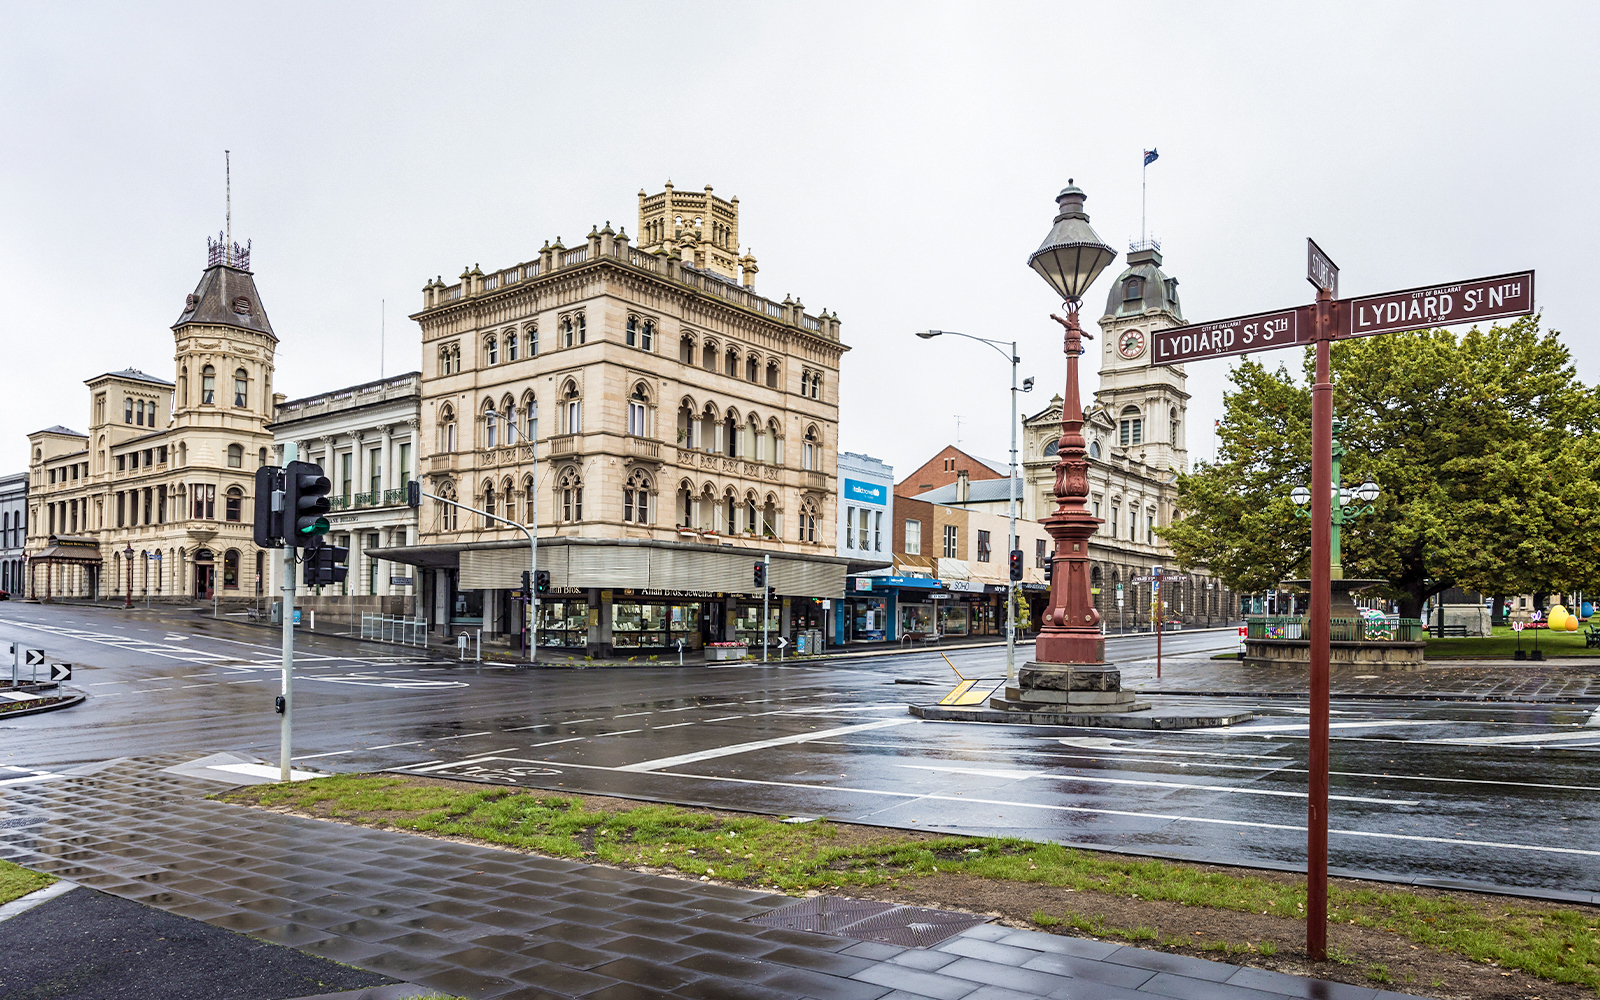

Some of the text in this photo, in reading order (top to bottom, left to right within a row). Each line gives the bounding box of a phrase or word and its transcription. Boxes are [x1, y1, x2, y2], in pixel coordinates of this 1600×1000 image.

[1312, 254, 1328, 288] STURT
[1433, 286, 1462, 296] BALLARAT
[1359, 282, 1521, 327] LYDIARD ST NTH
[1218, 320, 1241, 330] BALLARAT
[1160, 317, 1288, 357] LYDIARD ST STH
[563, 585, 582, 594] Bros.
[954, 581, 970, 591] SOHO
